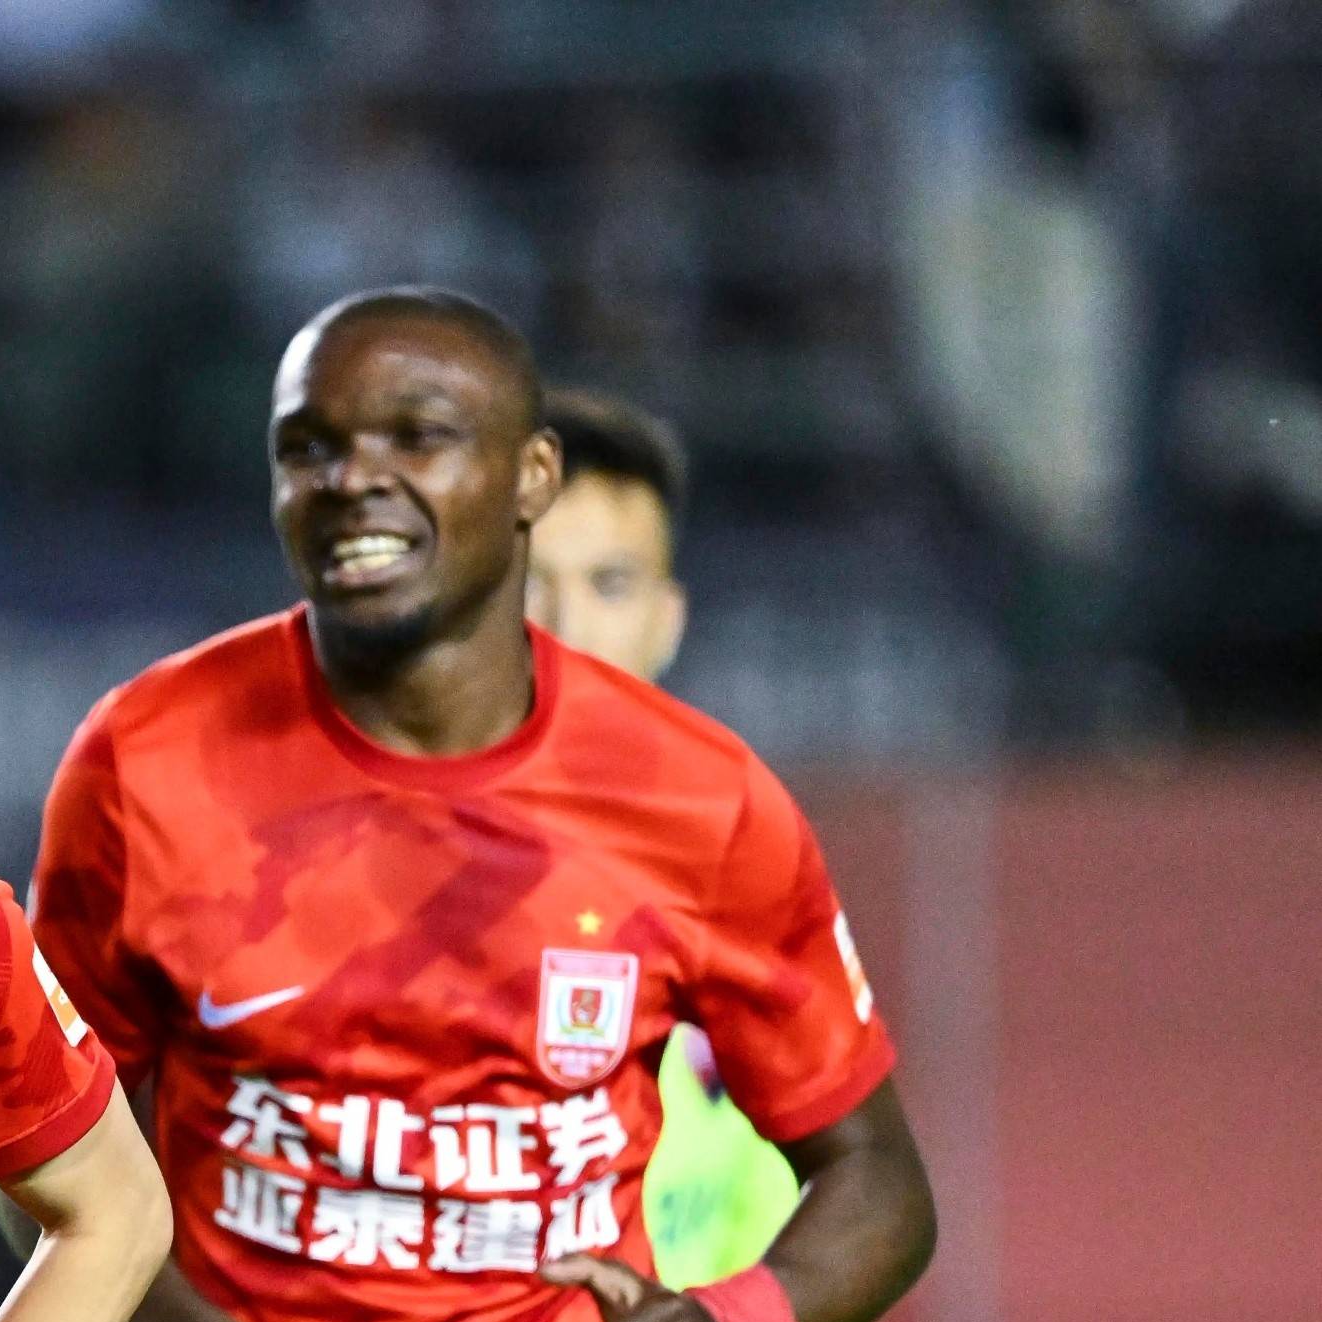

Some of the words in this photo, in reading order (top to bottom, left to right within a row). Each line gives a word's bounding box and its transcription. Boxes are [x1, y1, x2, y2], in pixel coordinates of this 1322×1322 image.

[219, 1074, 628, 1191] 东北证券
[213, 1172, 621, 1273] 亚泰建材
